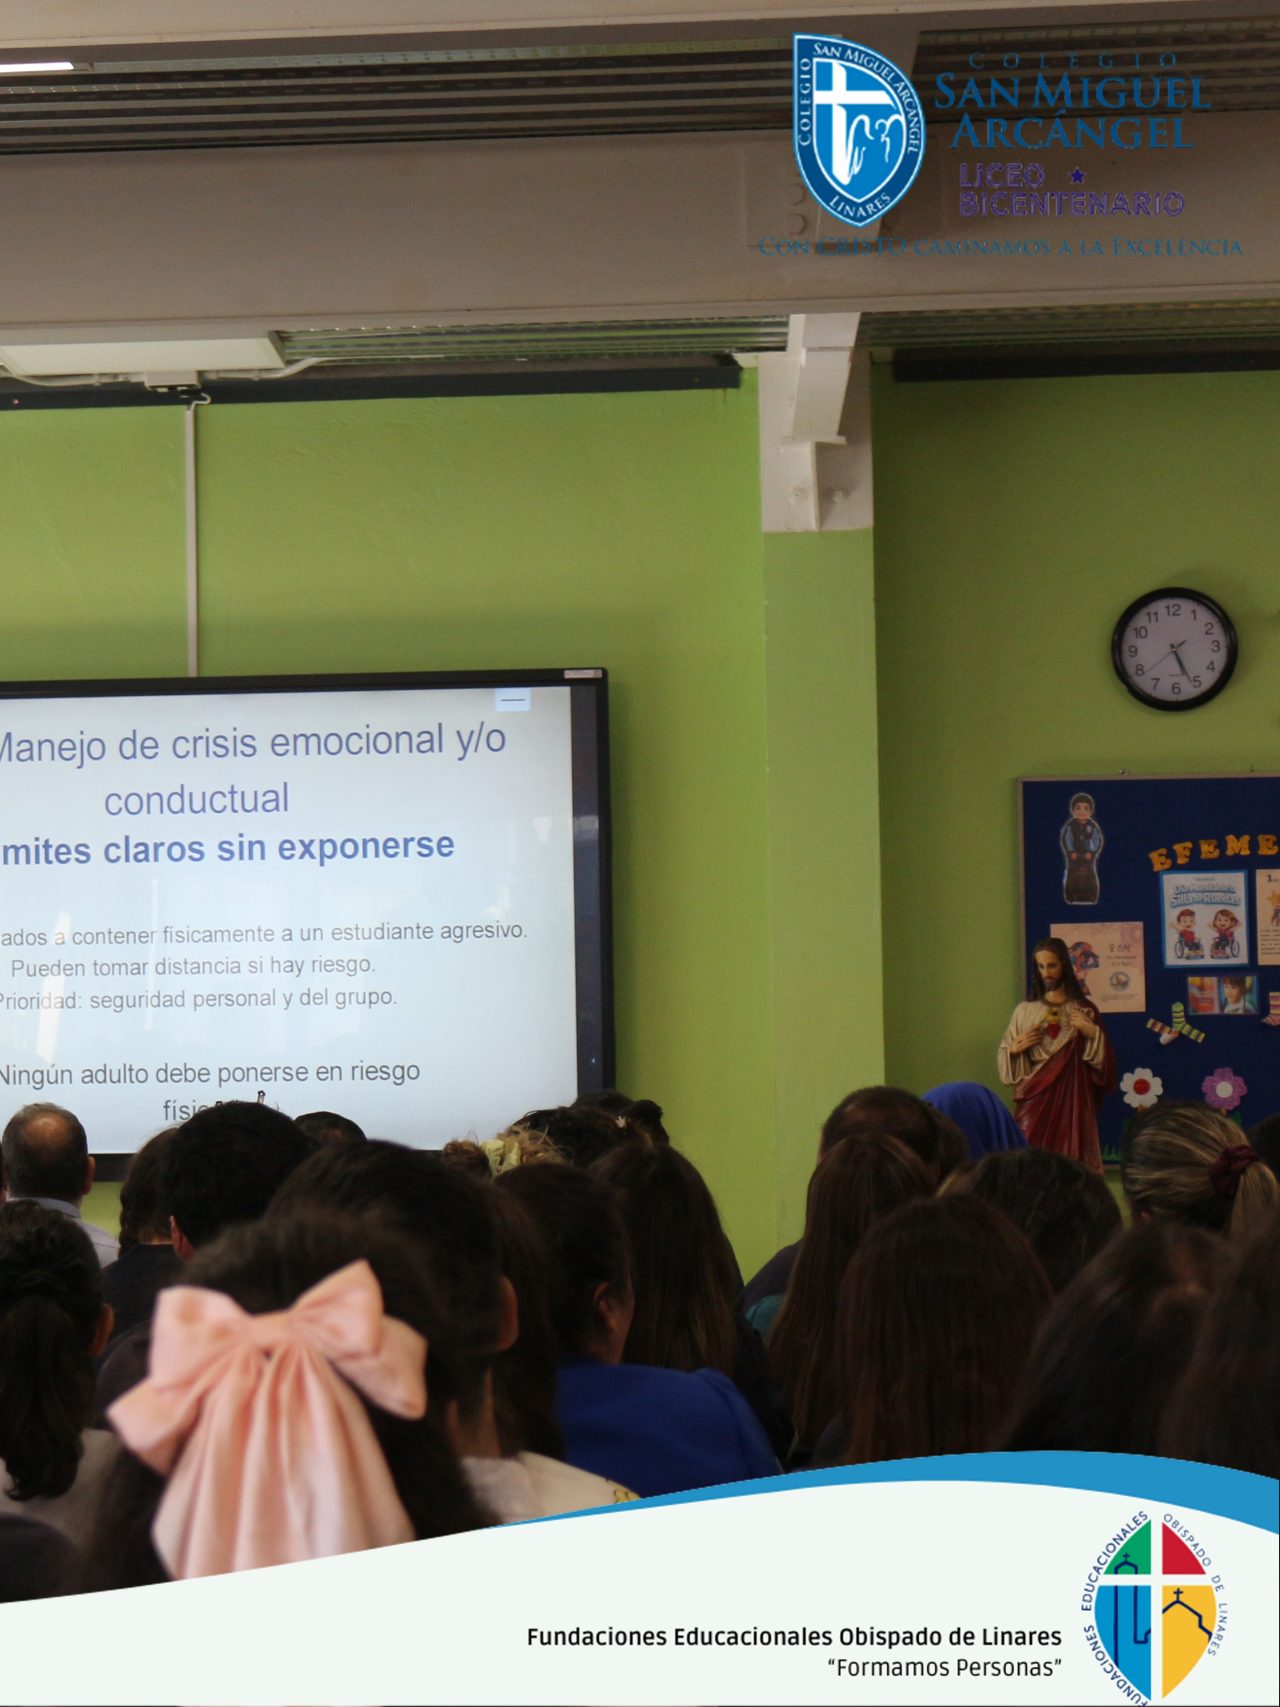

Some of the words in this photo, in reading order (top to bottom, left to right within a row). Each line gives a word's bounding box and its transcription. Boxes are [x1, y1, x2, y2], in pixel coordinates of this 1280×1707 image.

[1165, 603, 1181, 617] 12
[1190, 608, 1197, 621] 1
[1146, 611, 1159, 624] 11
[1133, 626, 1148, 639] 10
[1204, 622, 1214, 635] 2
[1128, 645, 1138, 658] 9
[1211, 640, 1221, 653] 3
[1135, 664, 1145, 676] 8
[1206, 661, 1215, 672] 4
[1151, 677, 1161, 690] 7
[1171, 682, 1181, 695] 6
[1192, 675, 1202, 689] 5
[119, 729, 160, 760] de
[171, 726, 258, 759] crisis
[270, 722, 444, 757] emocional
[455, 721, 507, 759] y/o
[104, 783, 290, 816] conductual
[103, 834, 206, 864] claros
[217, 832, 267, 862] sin
[277, 831, 456, 868] exponerse
[54, 932, 66, 946] a
[72, 928, 158, 946] contener
[281, 927, 294, 942] a
[299, 927, 324, 942] un
[331, 922, 435, 942] estudiante
[440, 921, 528, 944] agresivo.
[11, 959, 86, 978] Pueden
[92, 959, 150, 977] tomar
[155, 956, 242, 976] distancia
[247, 956, 264, 975] si
[270, 955, 306, 979] hay
[311, 955, 376, 978] riesgo.
[89, 989, 186, 1014] seguridad
[192, 987, 276, 1012] personal
[282, 992, 294, 1012] y
[299, 987, 329, 1007] del
[334, 990, 399, 1011] grupo.
[80, 1062, 149, 1085] adulto
[154, 1062, 212, 1084] debe
[217, 1064, 310, 1089] ponerse
[315, 1064, 343, 1082] en
[350, 1059, 421, 1086] riesgo
